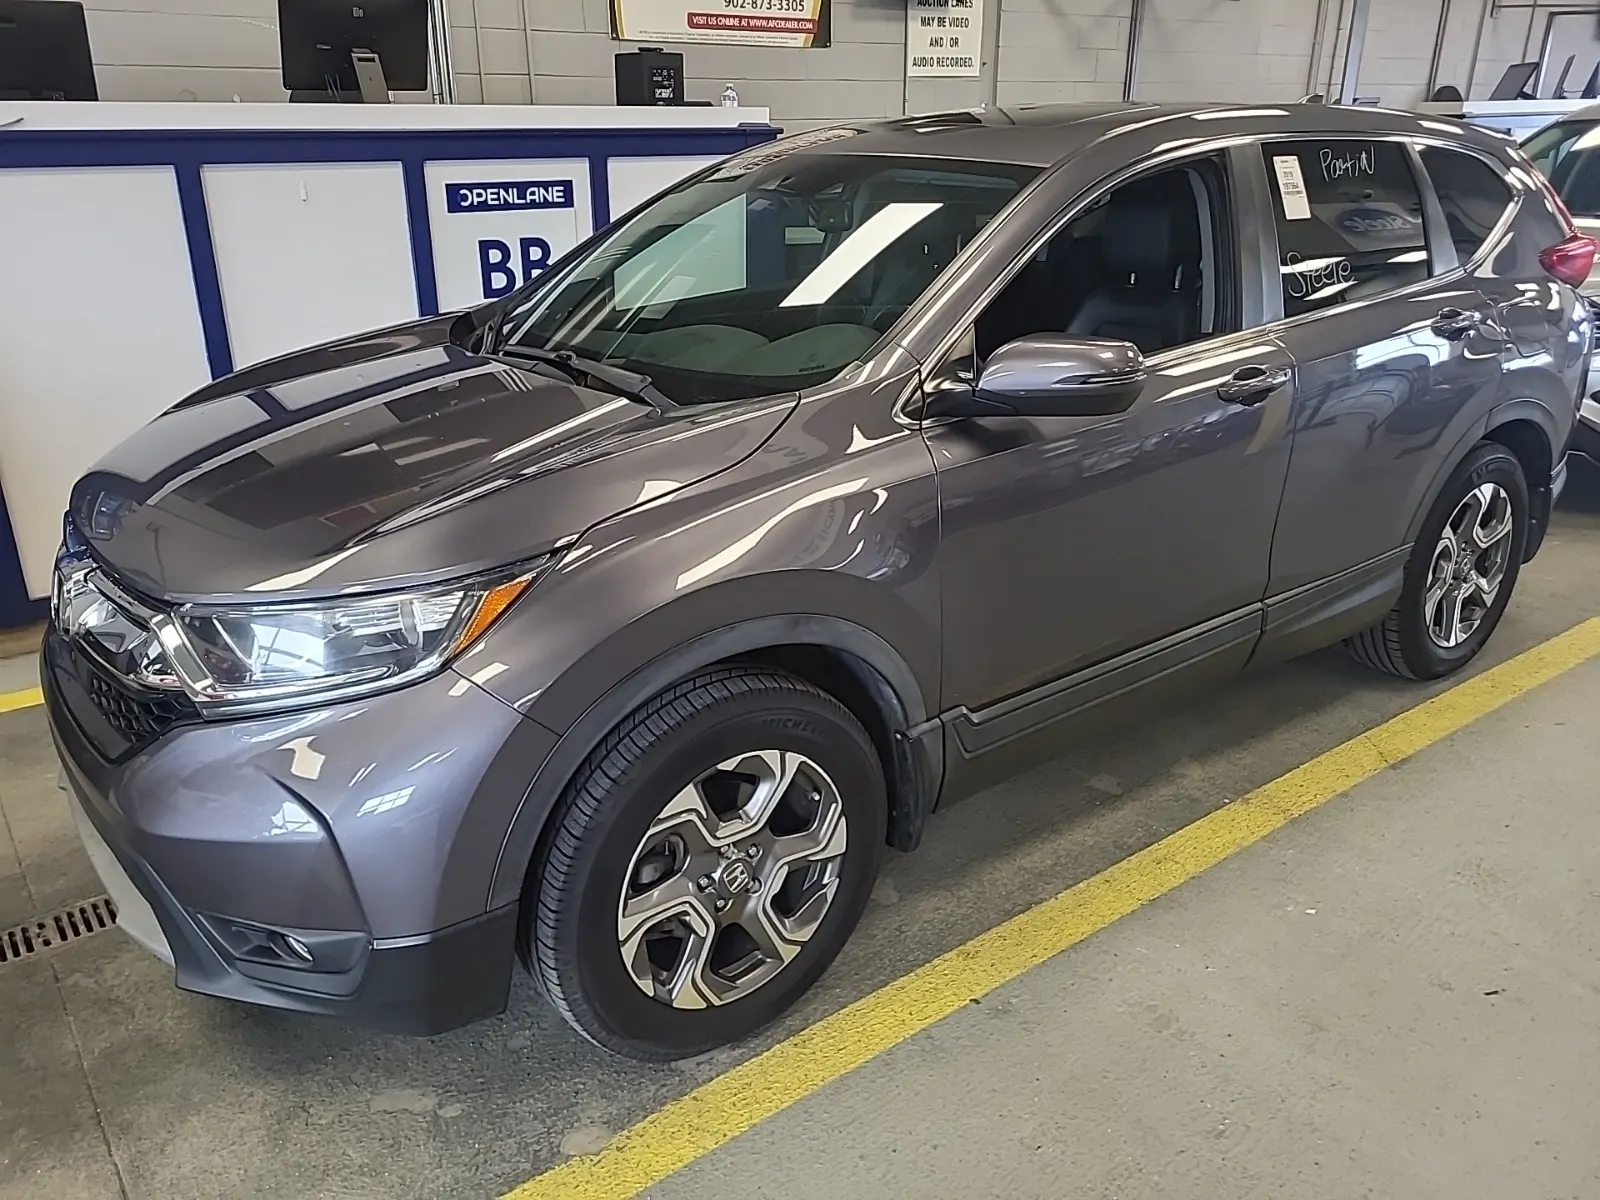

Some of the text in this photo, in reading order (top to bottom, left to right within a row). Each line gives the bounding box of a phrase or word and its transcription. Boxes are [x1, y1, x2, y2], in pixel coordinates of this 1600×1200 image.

[724, 0, 805, 12] 902-873-3305
[917, 0, 974, 8] AUCTION LANES
[692, 15, 707, 25] VISIT
[708, 16, 717, 25] US
[717, 17, 740, 26] ONLINE
[741, 18, 748, 27] AT
[920, 16, 970, 28] MAY BE VIDEO
[929, 36, 944, 48] AND
[949, 36, 960, 48] OR
[912, 56, 974, 68] AUDIO RECORDED.
[458, 186, 566, 207] OPENLANE
